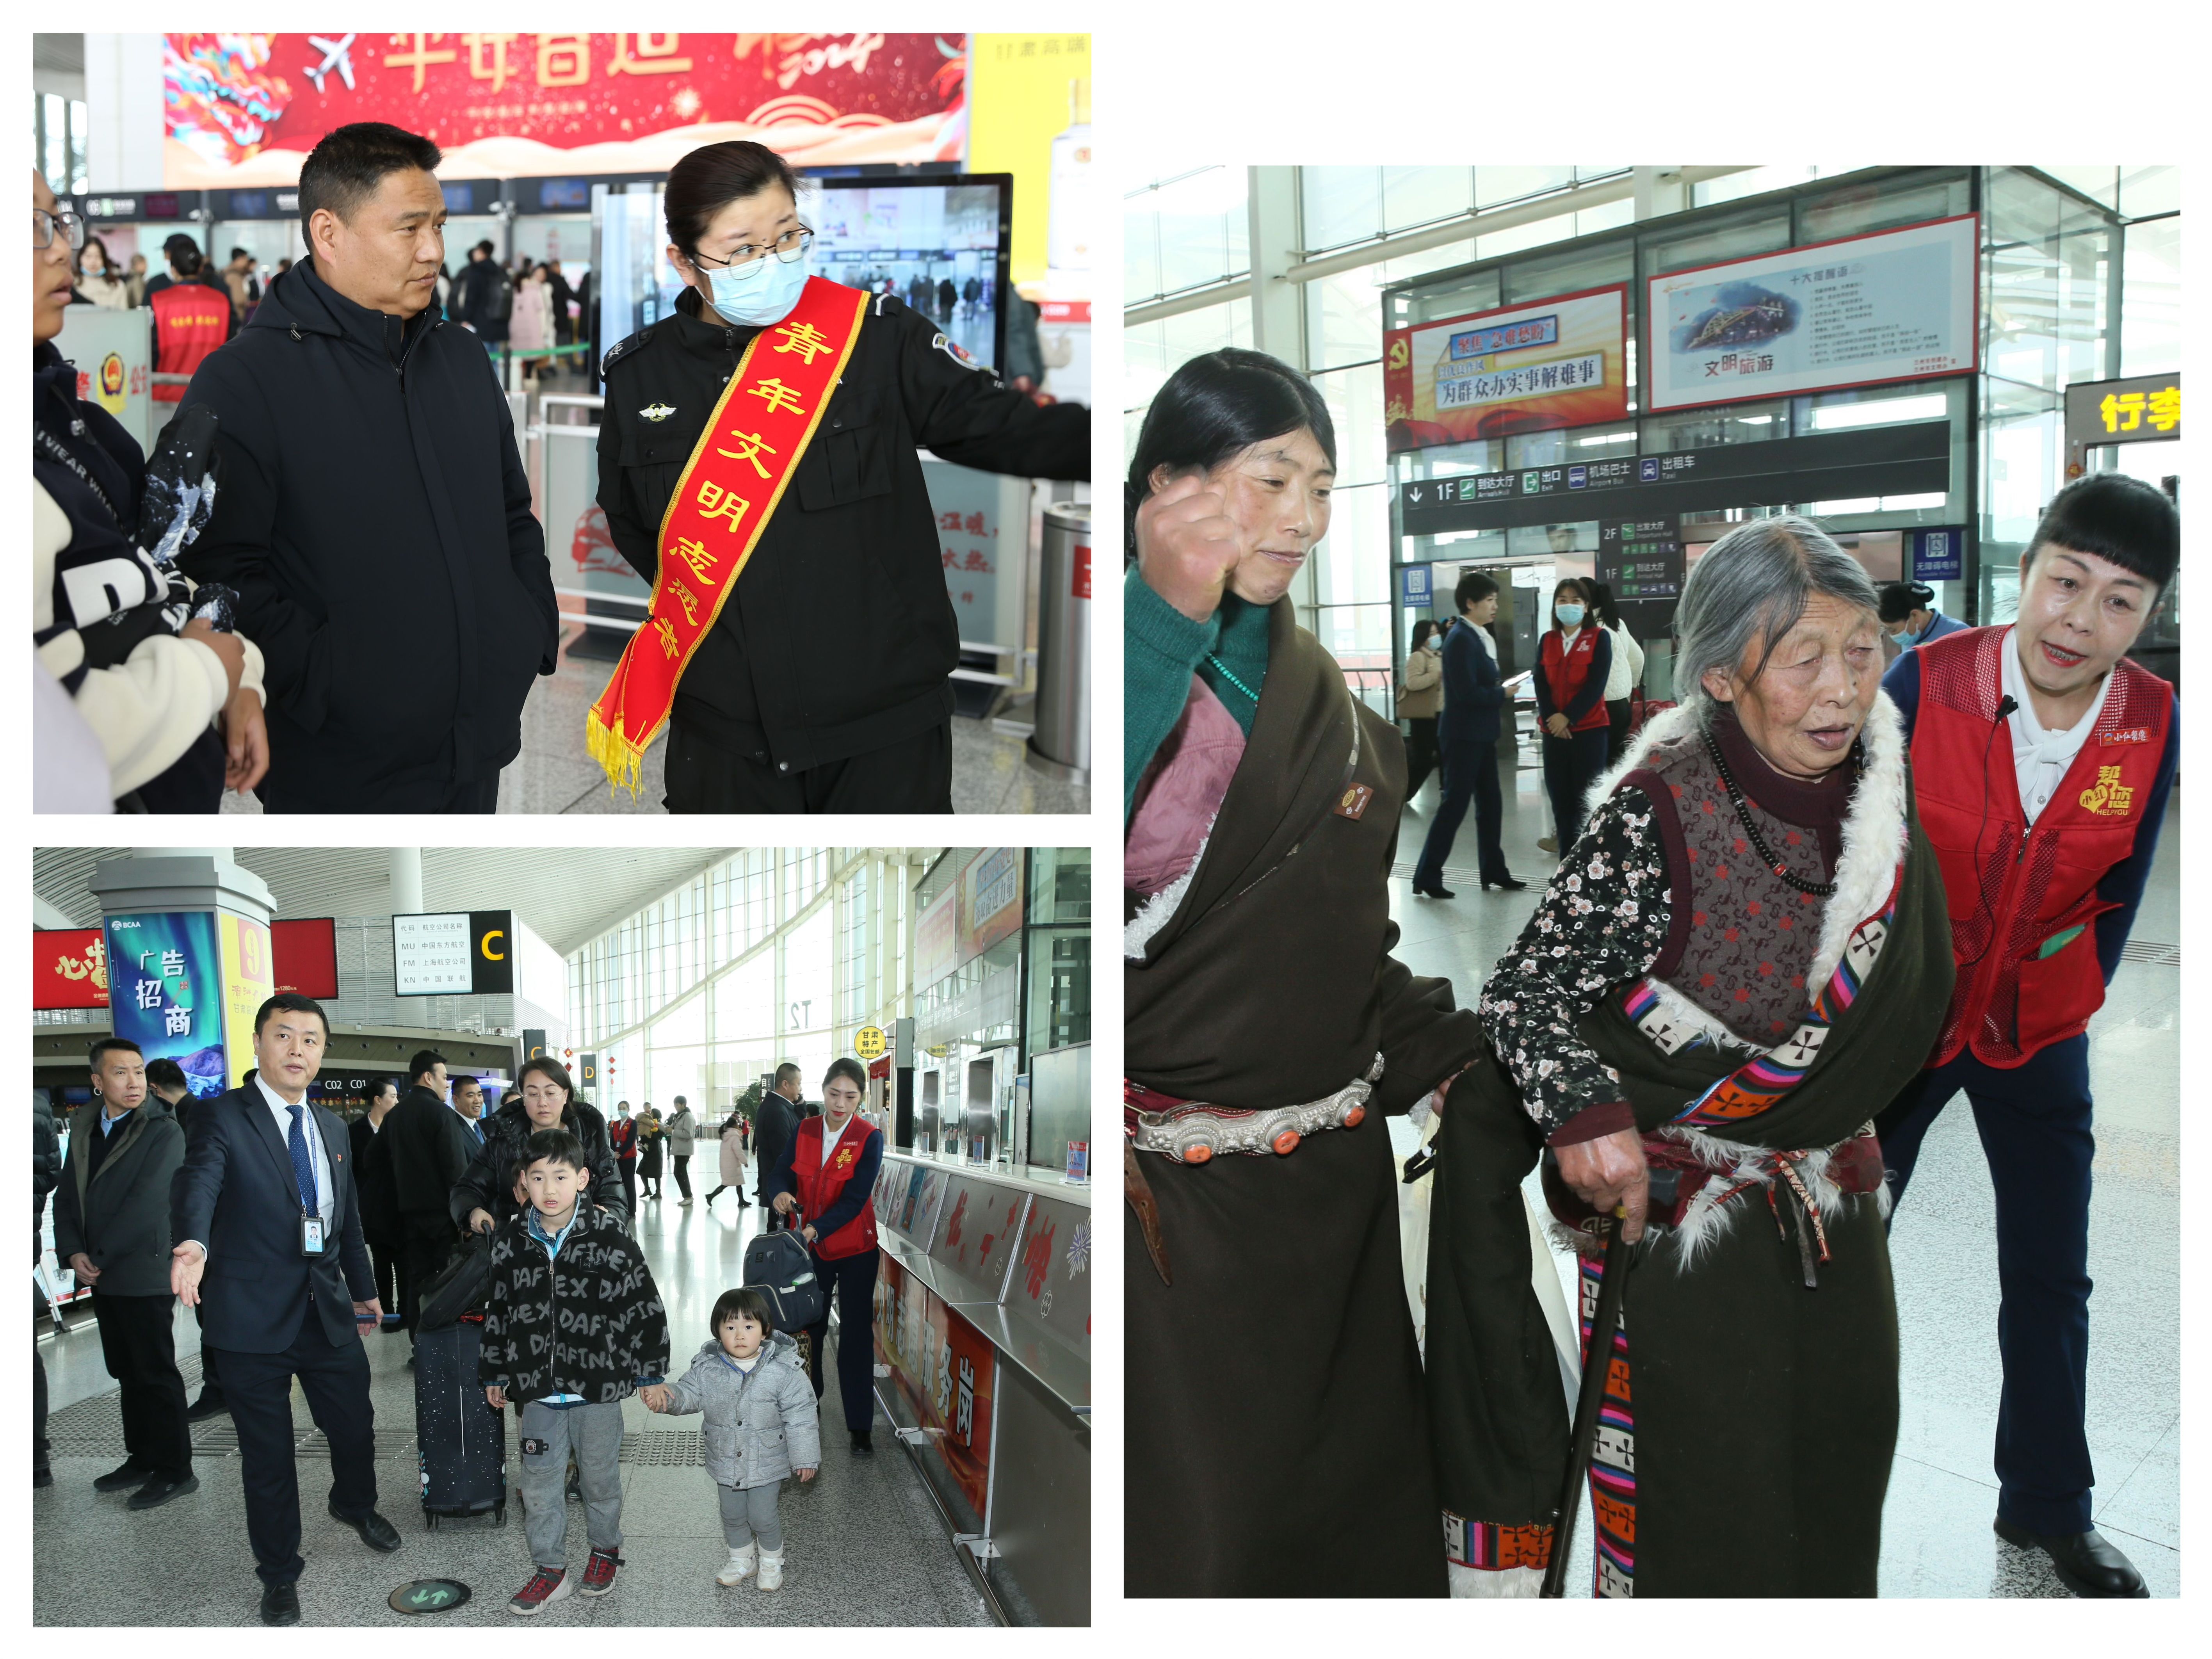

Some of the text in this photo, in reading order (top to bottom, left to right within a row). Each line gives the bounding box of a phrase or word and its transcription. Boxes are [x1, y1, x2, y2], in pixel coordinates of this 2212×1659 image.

[1790, 266, 1848, 285] 十大提醒语
[1705, 353, 1774, 377] 文明旅游
[1441, 359, 1595, 405] 为群众办实事解难事
[2100, 386, 2180, 433] 行李
[1436, 454, 1695, 501] 1F 到达大厅 出口 机场巴士 出租车
[1589, 479, 1612, 488] Airport
[655, 321, 834, 660] 青年文明志愿者
[1604, 528, 1617, 539] 2F
[1916, 560, 1959, 571] 无障碍电梯
[1605, 568, 1617, 579] 1F
[422, 941, 465, 949] 中国东方航空
[481, 930, 504, 961] C
[140, 949, 185, 977] 广告
[422, 958, 466, 967] 上海航空公司
[423, 974, 466, 983] 中国联航
[862, 1031, 878, 1039] 甘肃
[585, 1066, 594, 1079] D
[325, 1080, 343, 1089] C02
[350, 1080, 366, 1089] C01
[876, 1273, 975, 1448] 文明志愿服务岗
[594, 1551, 612, 1560] SKECHERS
